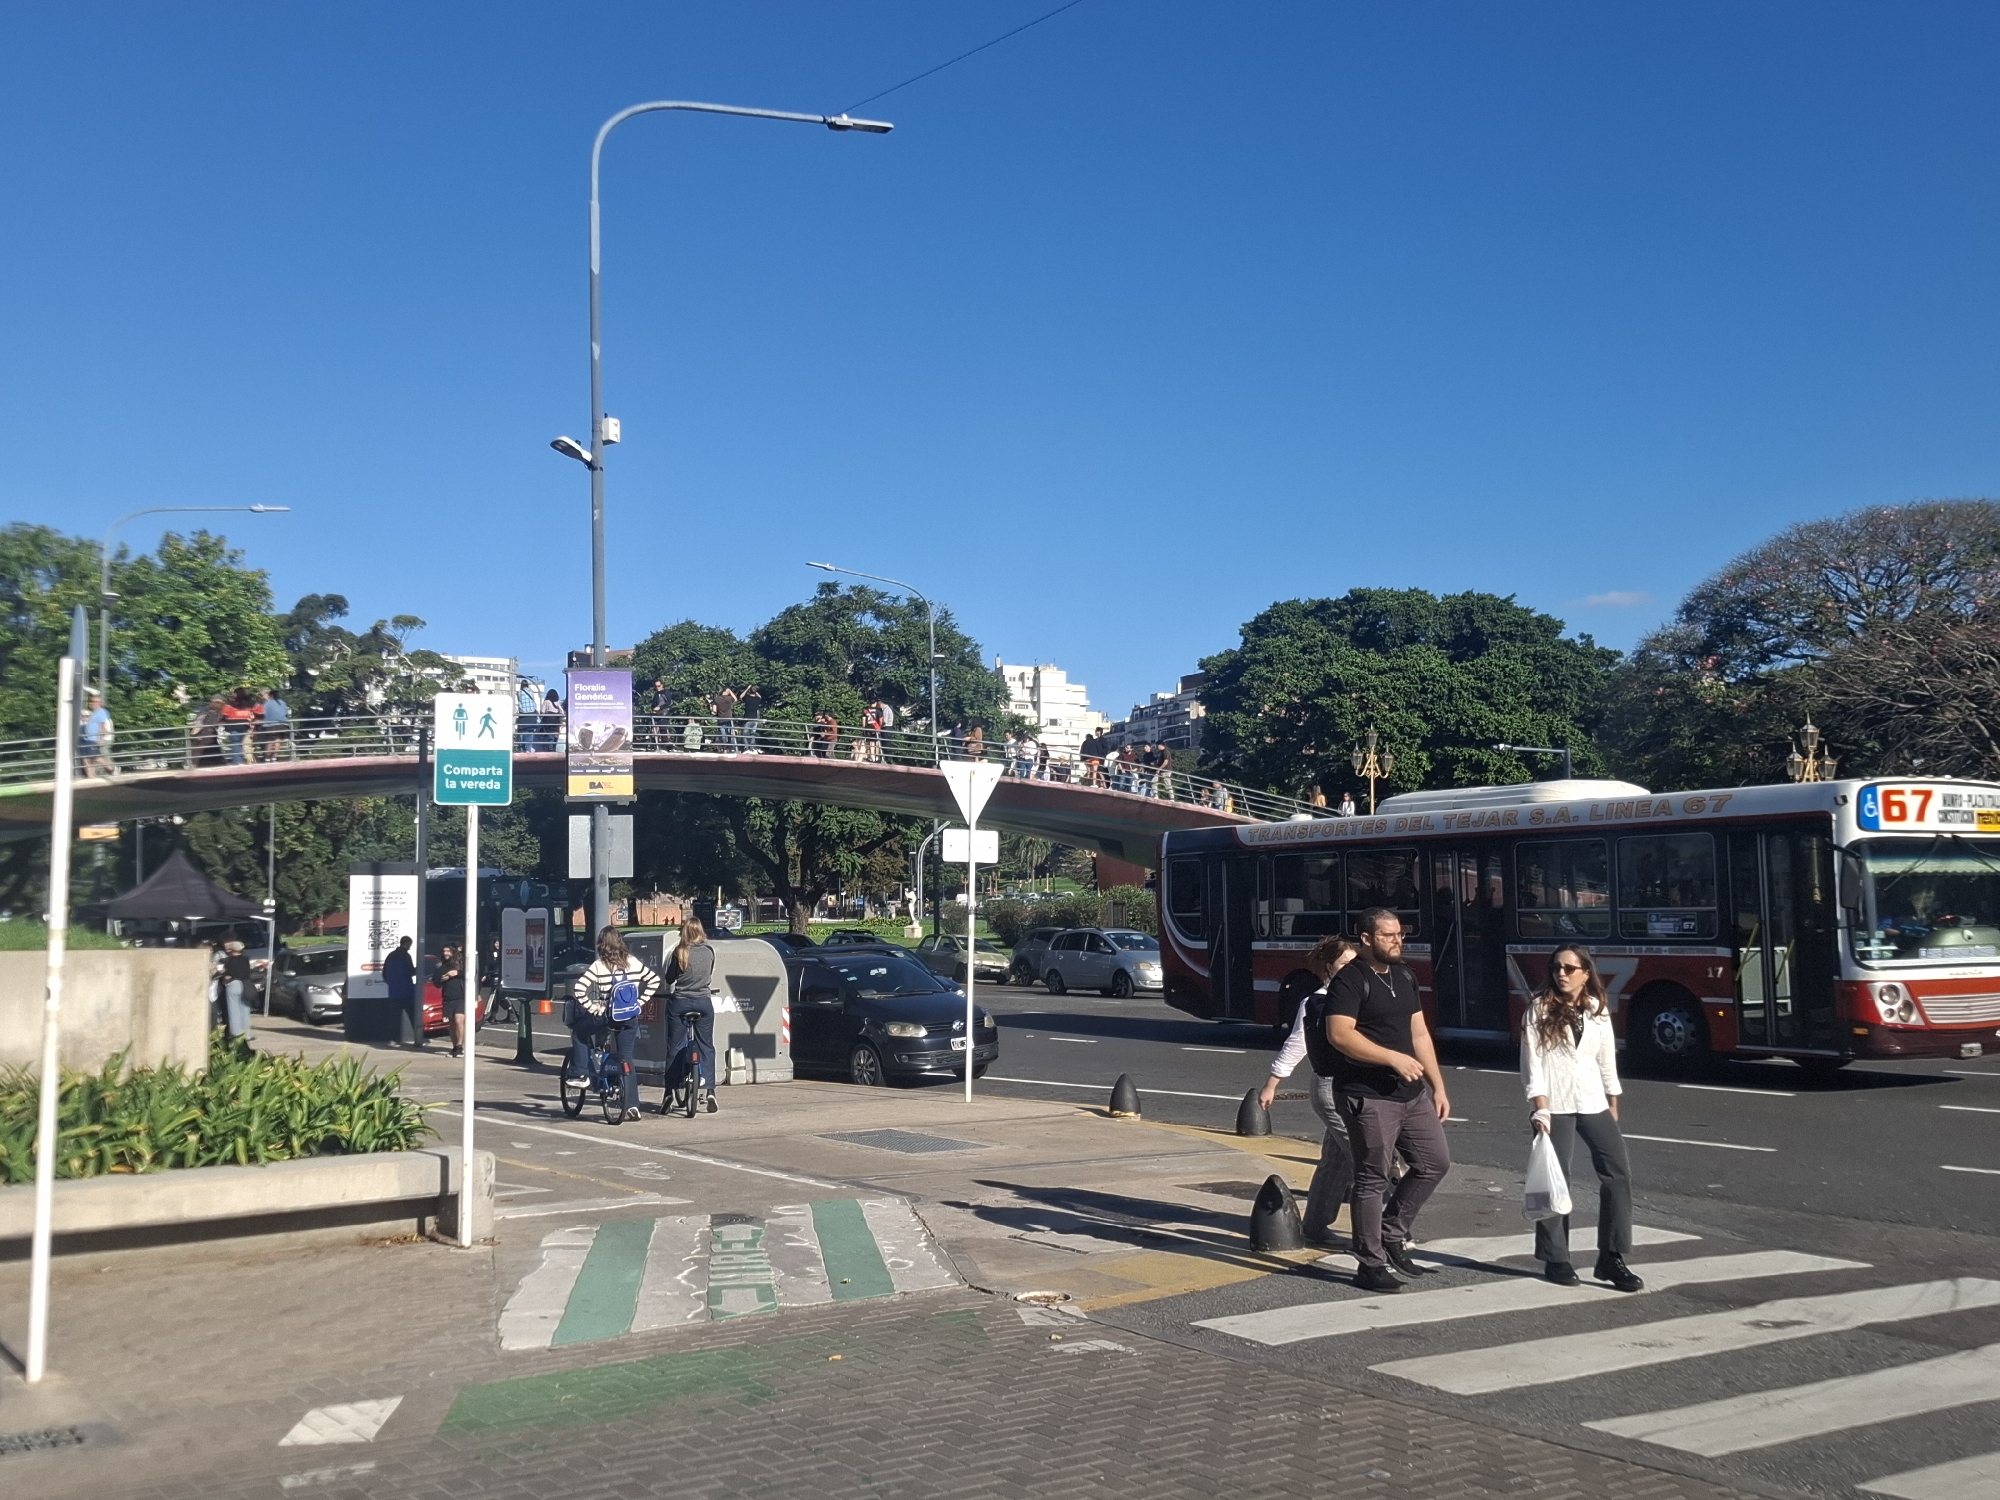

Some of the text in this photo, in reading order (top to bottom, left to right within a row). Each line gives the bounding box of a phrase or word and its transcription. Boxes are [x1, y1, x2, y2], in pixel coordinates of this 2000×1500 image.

[574, 683, 606, 691] Floralis
[574, 692, 614, 700] Genérica
[443, 763, 503, 777] Comparta
[445, 778, 501, 790] la vereda
[1881, 789, 1933, 822] 67
[1248, 794, 1733, 843] TRANSPORTES DEL TEJAR S.A. LINEA 67
[649, 955, 657, 967] 21
[1706, 966, 1724, 979] 17
